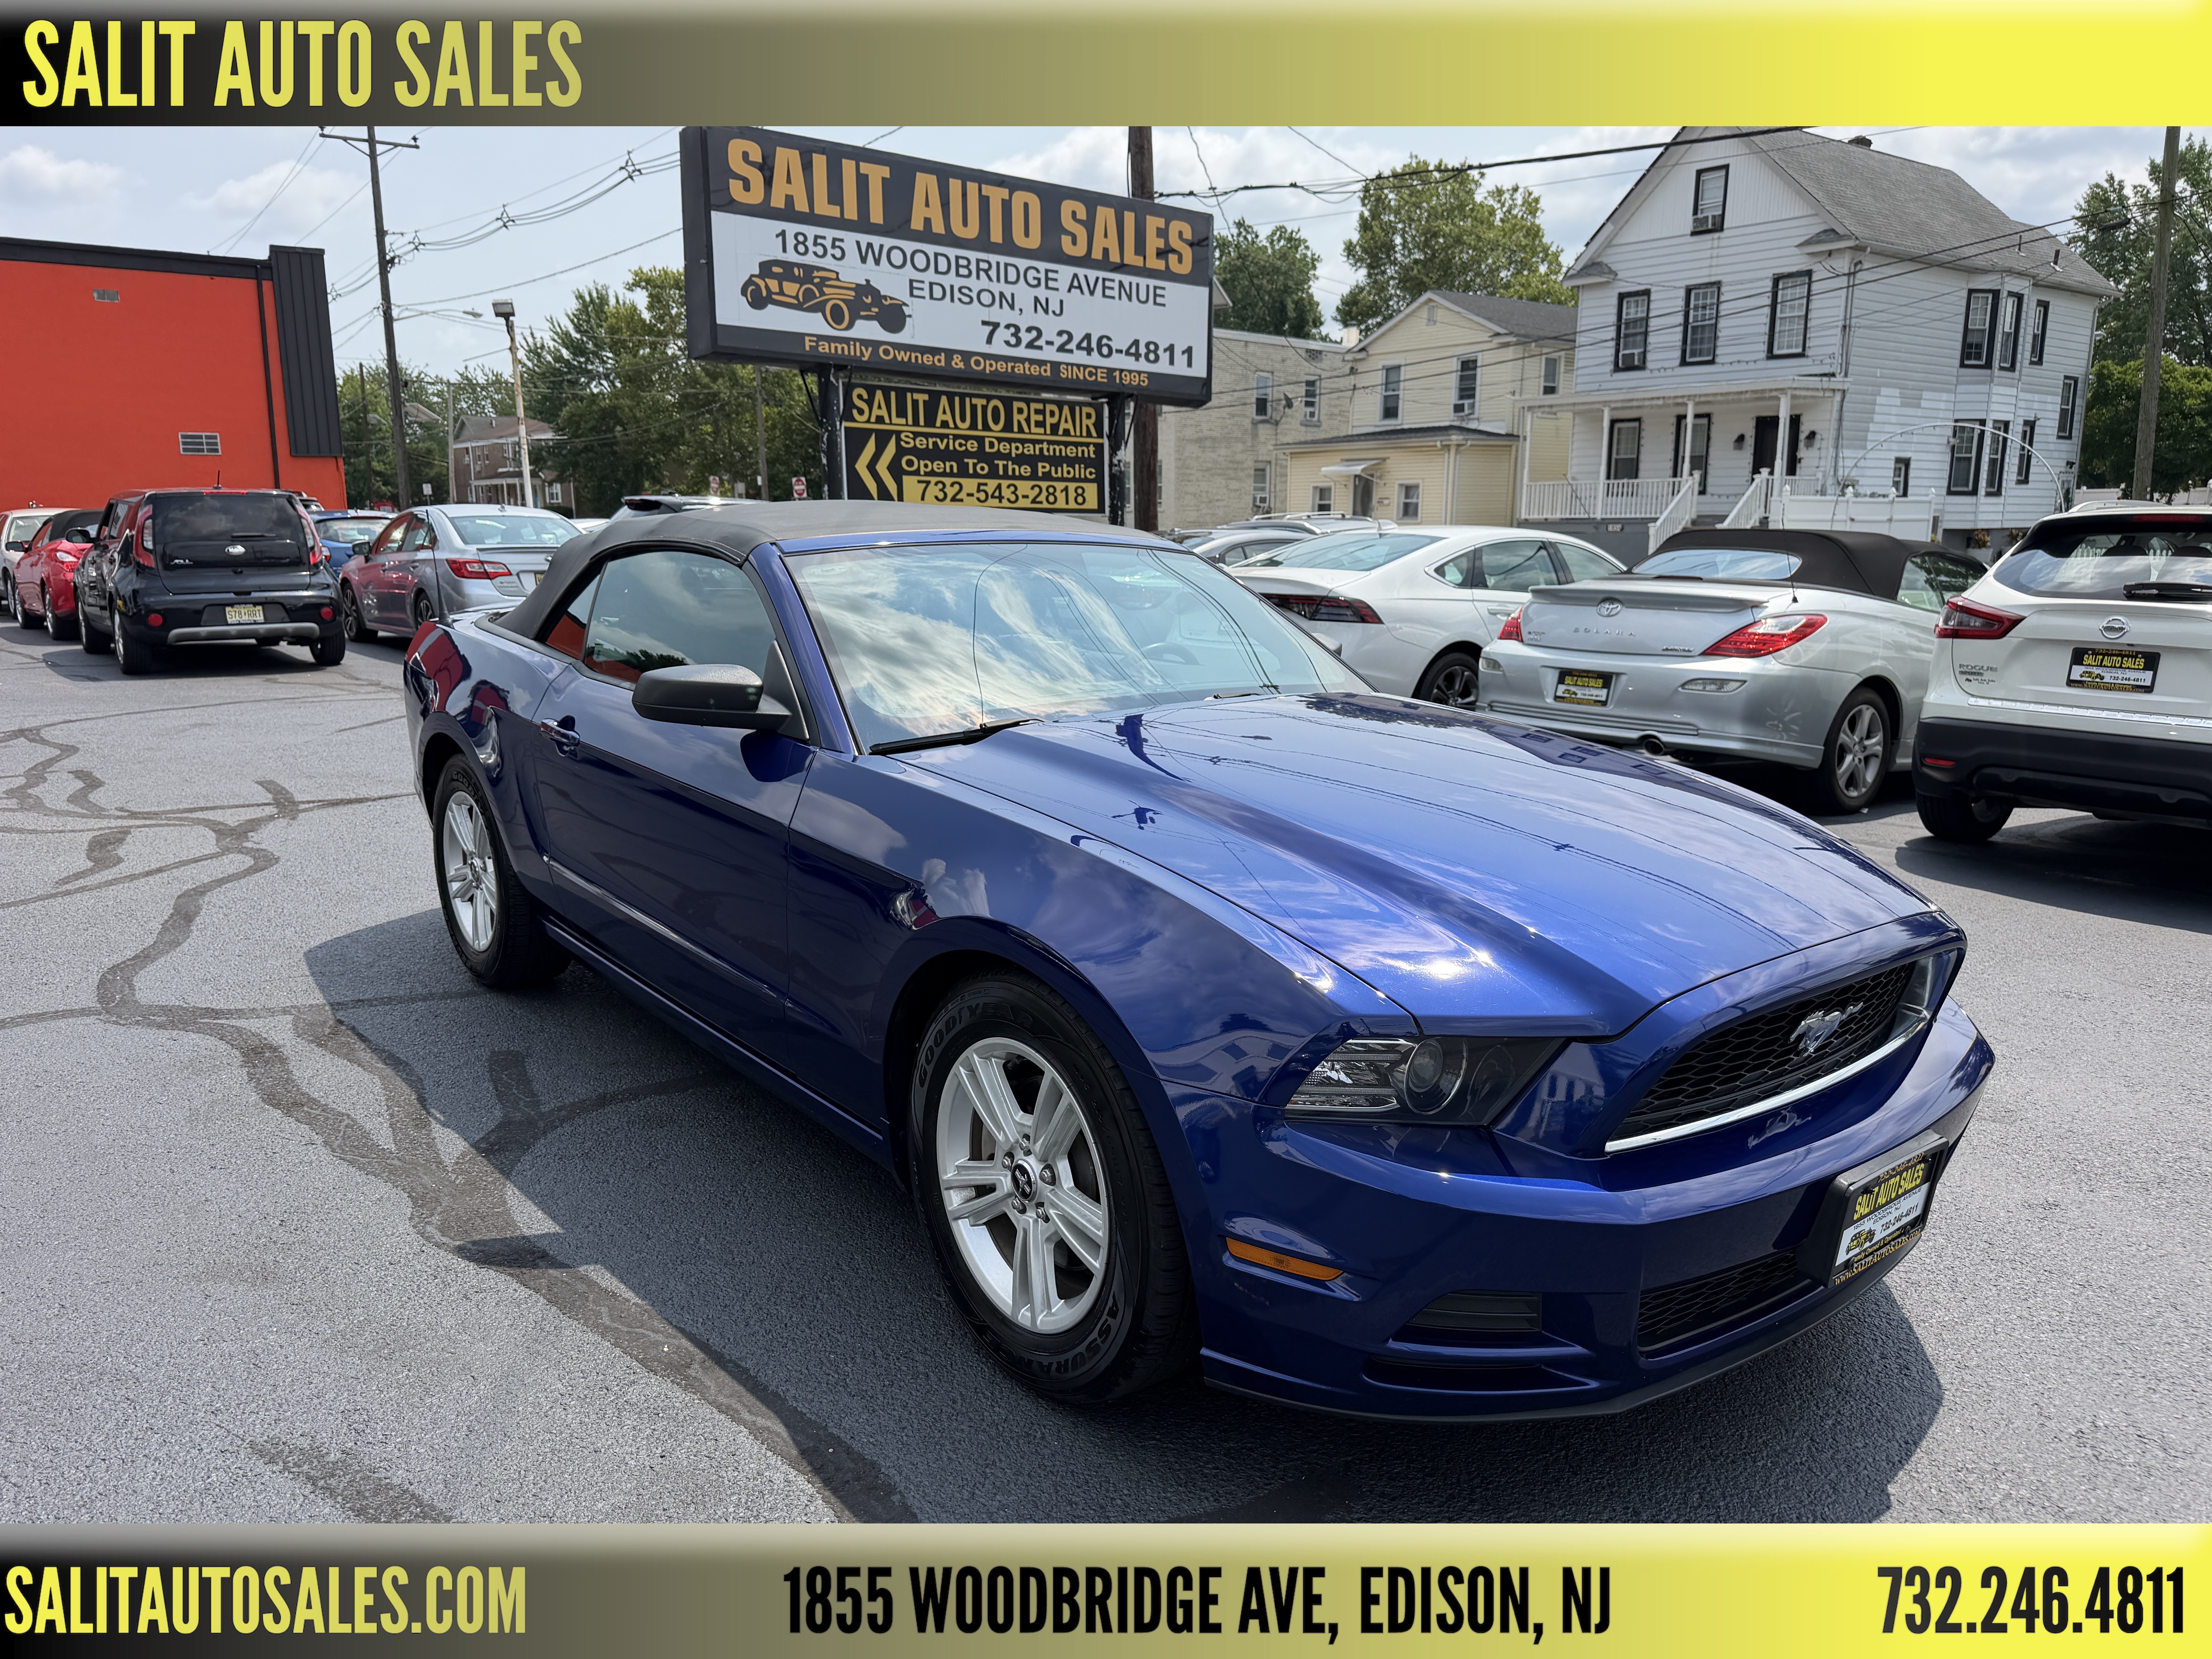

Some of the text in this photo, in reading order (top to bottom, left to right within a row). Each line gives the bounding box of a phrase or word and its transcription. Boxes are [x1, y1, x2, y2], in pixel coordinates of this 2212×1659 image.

[728, 139, 1193, 274] SALIT AUTO SALES
[775, 229, 1167, 307] 1855 WOODBRIDGE AVENUE
[909, 279, 1064, 317] EDISON, NJ
[804, 336, 1149, 386] Family Owned & Operated SINCE 1995
[981, 320, 1193, 368] 732-246-4811
[852, 387, 1098, 438] SALIT AUTO REPAIR
[900, 432, 1096, 458] Service Department
[901, 455, 1096, 479] Open To The Public
[917, 480, 1086, 506] 732-543-2818
[1959, 664, 1997, 672] ROGUE
[2083, 654, 2145, 669] SALIT AUTO SALES
[1854, 1163, 1925, 1220] SALIT AUTO SALES
[1867, 1199, 1902, 1224] WOODBRIDGE
[1902, 1187, 1922, 1202] AVENUE
[1880, 1202, 1919, 1234] 732-246-4811
